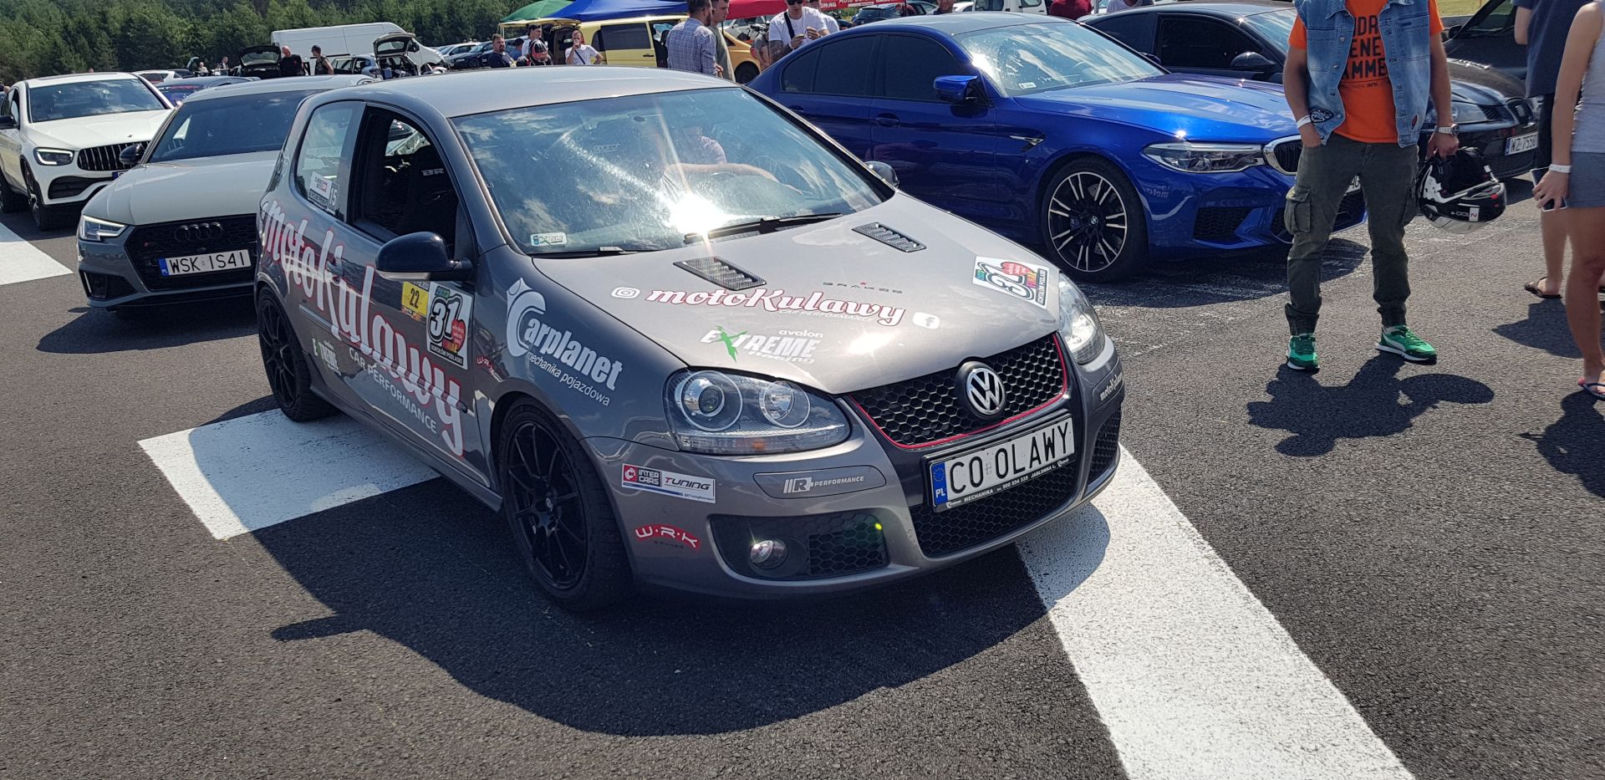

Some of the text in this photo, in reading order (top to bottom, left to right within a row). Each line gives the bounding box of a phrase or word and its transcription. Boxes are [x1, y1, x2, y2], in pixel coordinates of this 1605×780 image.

[169, 257, 201, 274] WSK
[410, 287, 420, 309] 22
[646, 287, 906, 327] motoKulawy
[429, 293, 463, 344] 31
[699, 326, 821, 362] EXTREME
[778, 329, 825, 339] avalon
[349, 346, 367, 372] CAR
[366, 363, 438, 435] PERFORMANCE
[559, 373, 611, 407] pojazdowa
[664, 476, 712, 491] TUNING
[814, 475, 865, 488] PERFORMANCE
